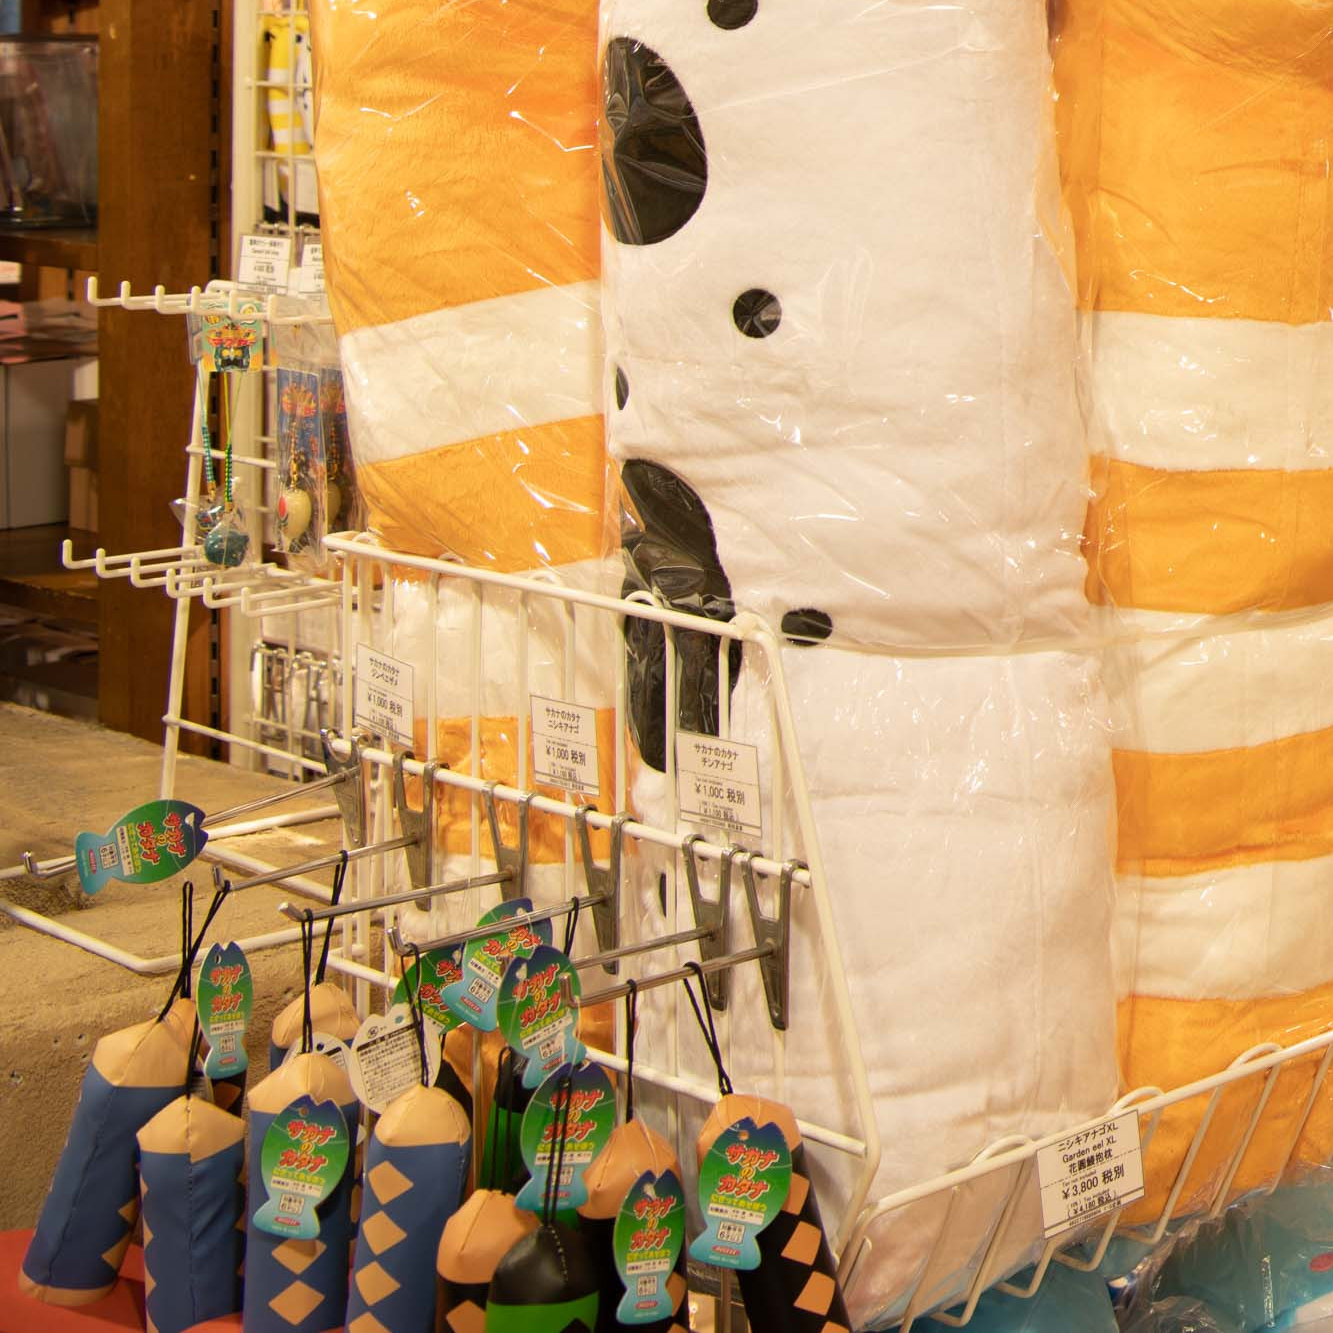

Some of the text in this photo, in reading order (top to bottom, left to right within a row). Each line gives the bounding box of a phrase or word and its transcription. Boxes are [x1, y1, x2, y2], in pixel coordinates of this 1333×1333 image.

[694, 744, 739, 761] サカナのカタナ
[136, 820, 161, 866] カタナ
[156, 834, 168, 847] の
[163, 812, 187, 858] サカナ
[507, 938, 519, 951] の
[513, 963, 560, 1001] サカナ
[534, 988, 546, 1003] の
[520, 992, 562, 1028] カタナ
[287, 1119, 337, 1146] サカナ
[1058, 1122, 1118, 1153] ニシキアナゴXL
[279, 1148, 329, 1173] カタナ
[300, 1141, 314, 1154] の
[725, 1143, 780, 1172] サカナ
[1062, 1135, 1117, 1164] Garden eel XL
[739, 1166, 756, 1180] の
[1102, 1163, 1124, 1184] 税別
[716, 1174, 771, 1202] カタナ
[633, 1195, 677, 1221] サカナ
[647, 1216, 659, 1230] の
[629, 1226, 672, 1252] カタナ
